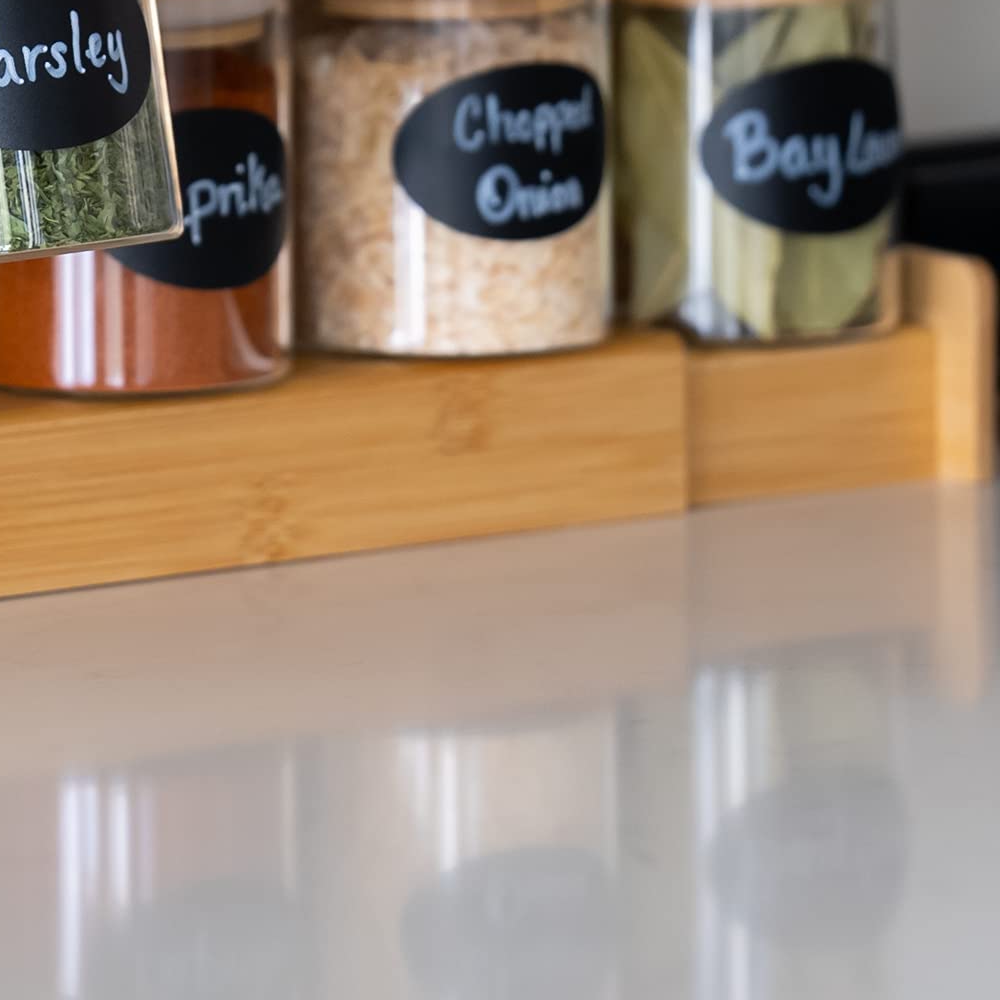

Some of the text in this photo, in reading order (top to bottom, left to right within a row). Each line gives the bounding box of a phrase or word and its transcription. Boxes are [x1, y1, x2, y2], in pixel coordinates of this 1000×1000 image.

[183, 152, 283, 247] prika
[475, 163, 584, 226] Onion
[722, 107, 844, 209] Bay
